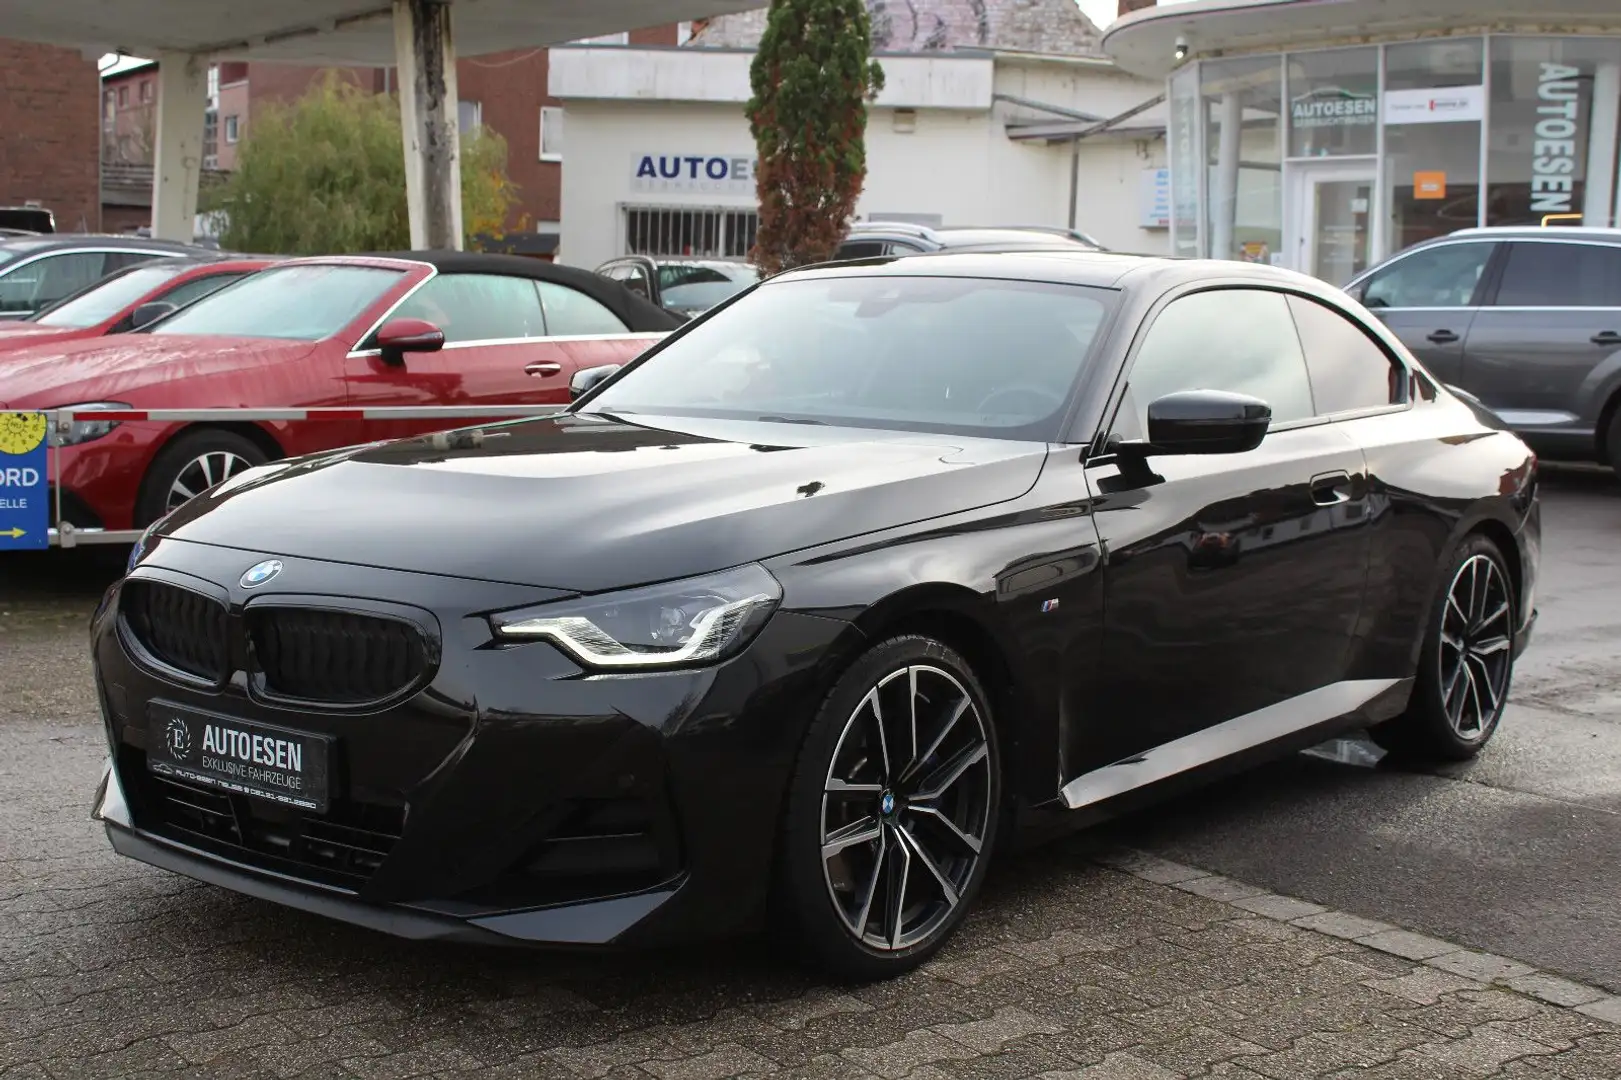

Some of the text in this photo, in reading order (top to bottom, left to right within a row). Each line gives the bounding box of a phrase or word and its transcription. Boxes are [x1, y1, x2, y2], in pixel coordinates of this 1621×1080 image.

[1293, 99, 1376, 118] AUTOESEN
[1530, 62, 1579, 211] AUTOESEN
[202, 724, 302, 773] AUTOESEN
[202, 755, 302, 790] EXKLUSIVE FAHRZEUGE
